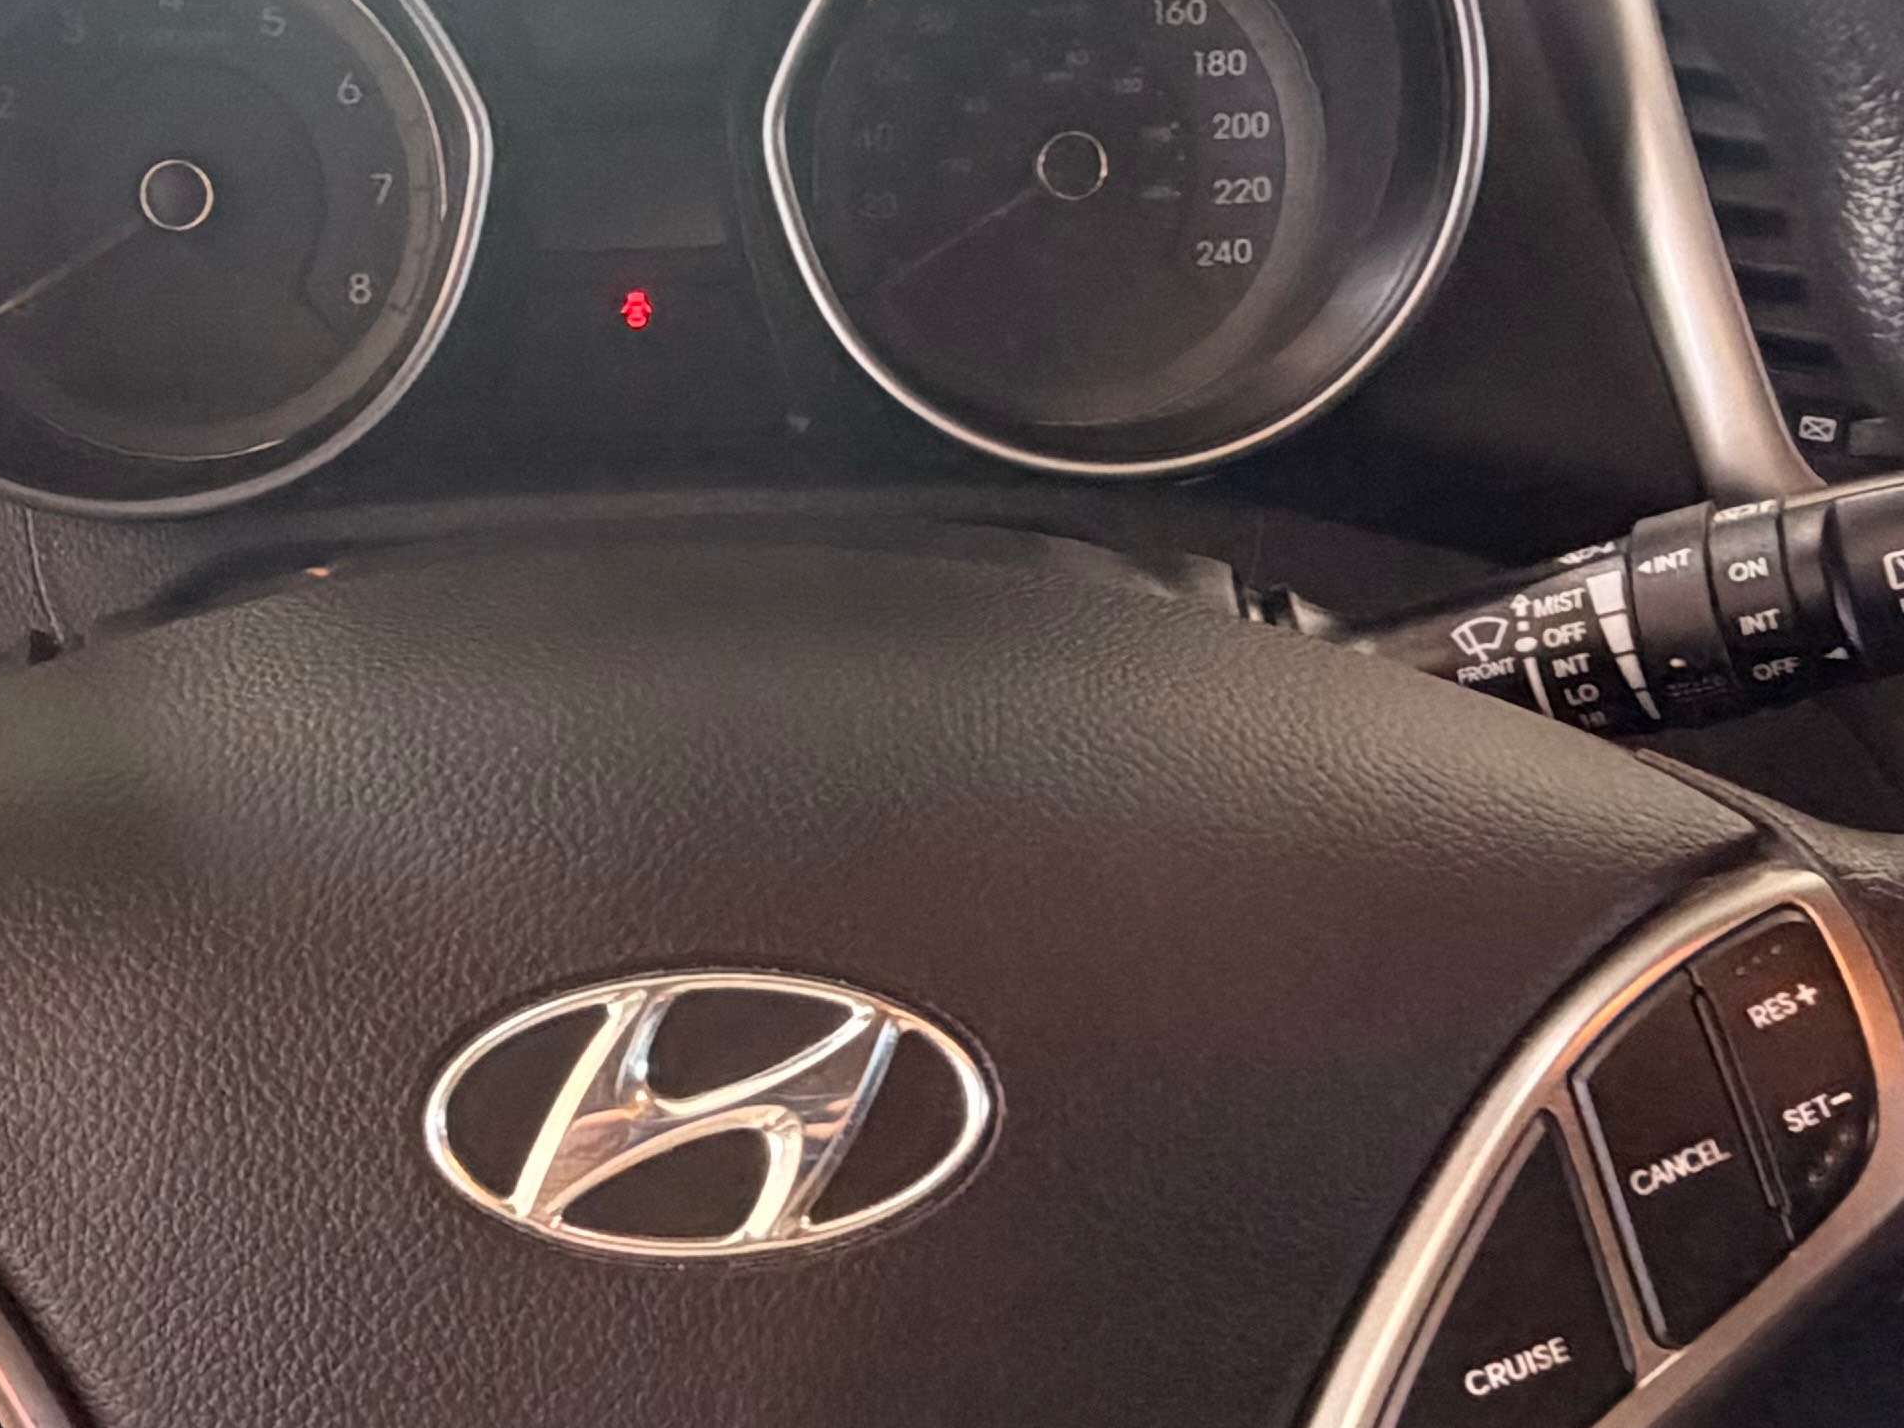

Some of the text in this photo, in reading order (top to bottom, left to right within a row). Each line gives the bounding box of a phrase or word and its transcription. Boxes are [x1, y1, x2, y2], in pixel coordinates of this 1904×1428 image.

[260, 7, 287, 38] 5
[1193, 48, 1248, 78] 180
[337, 71, 362, 105] 6
[1212, 111, 1271, 141] 200
[370, 171, 394, 207] 7
[1212, 176, 1273, 206] 220
[1195, 238, 1254, 268] 240
[348, 271, 372, 305] 8
[1653, 547, 1693, 573] INT
[1728, 557, 1769, 582] ON
[1533, 588, 1585, 618] MIST
[1542, 622, 1587, 648] OFF
[1738, 607, 1781, 636] INT
[1456, 656, 1516, 687] FRONT
[1552, 653, 1590, 678] INT
[1752, 657, 1800, 682] OFF
[1563, 683, 1600, 706] LO
[1628, 1137, 1734, 1197] CANCEL
[1463, 1335, 1573, 1397] CRUISE
